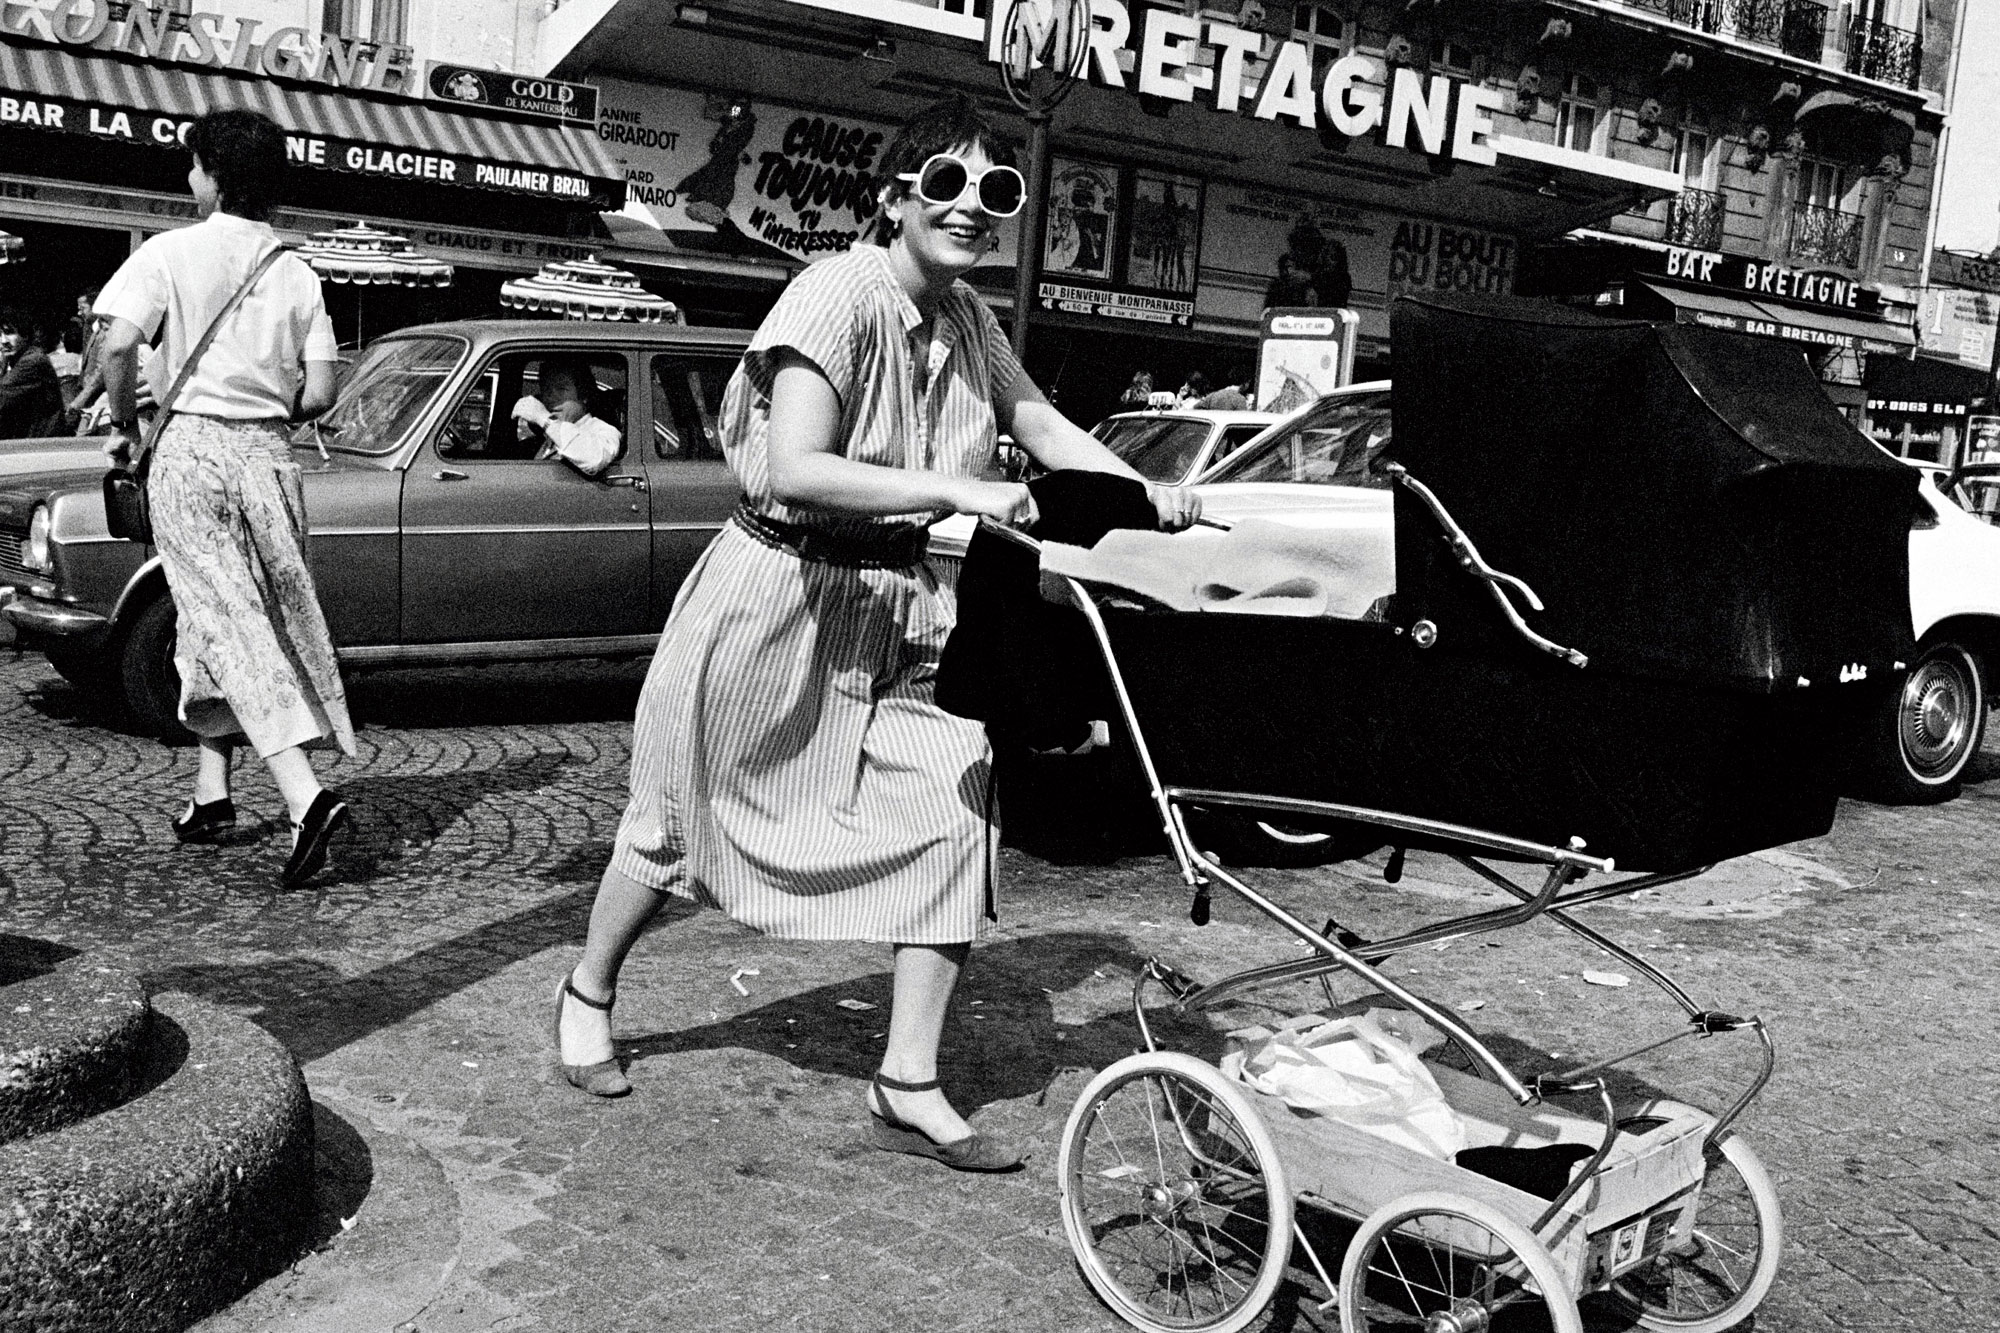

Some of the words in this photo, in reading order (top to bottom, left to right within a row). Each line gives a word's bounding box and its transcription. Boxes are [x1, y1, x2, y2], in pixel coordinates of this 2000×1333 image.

[505, 97, 517, 107] DE
[511, 79, 574, 103] GOLD
[601, 107, 642, 124] ANNIE
[0, 97, 63, 128] BAR
[90, 109, 133, 138] LA
[346, 147, 455, 181] GLACIER
[476, 164, 549, 192] PAULANER
[599, 122, 680, 151] GIRARDOT
[782, 117, 884, 170] CAUSE
[798, 210, 821, 230] TU
[425, 231, 492, 251] CHAUD
[502, 241, 526, 255] ET
[1391, 221, 1433, 255] AU
[1439, 227, 1514, 269] BOUT
[1388, 252, 1431, 286] DU
[1667, 250, 1713, 282] BAR
[1745, 263, 1859, 308] BRETAGNE
[1042, 285, 1056, 297] AU
[1060, 288, 1114, 305] BIENVENUE
[1118, 294, 1192, 314] MONTPARNASSE
[1746, 320, 1775, 336] BAR
[1782, 326, 1853, 347] BRETAGNE
